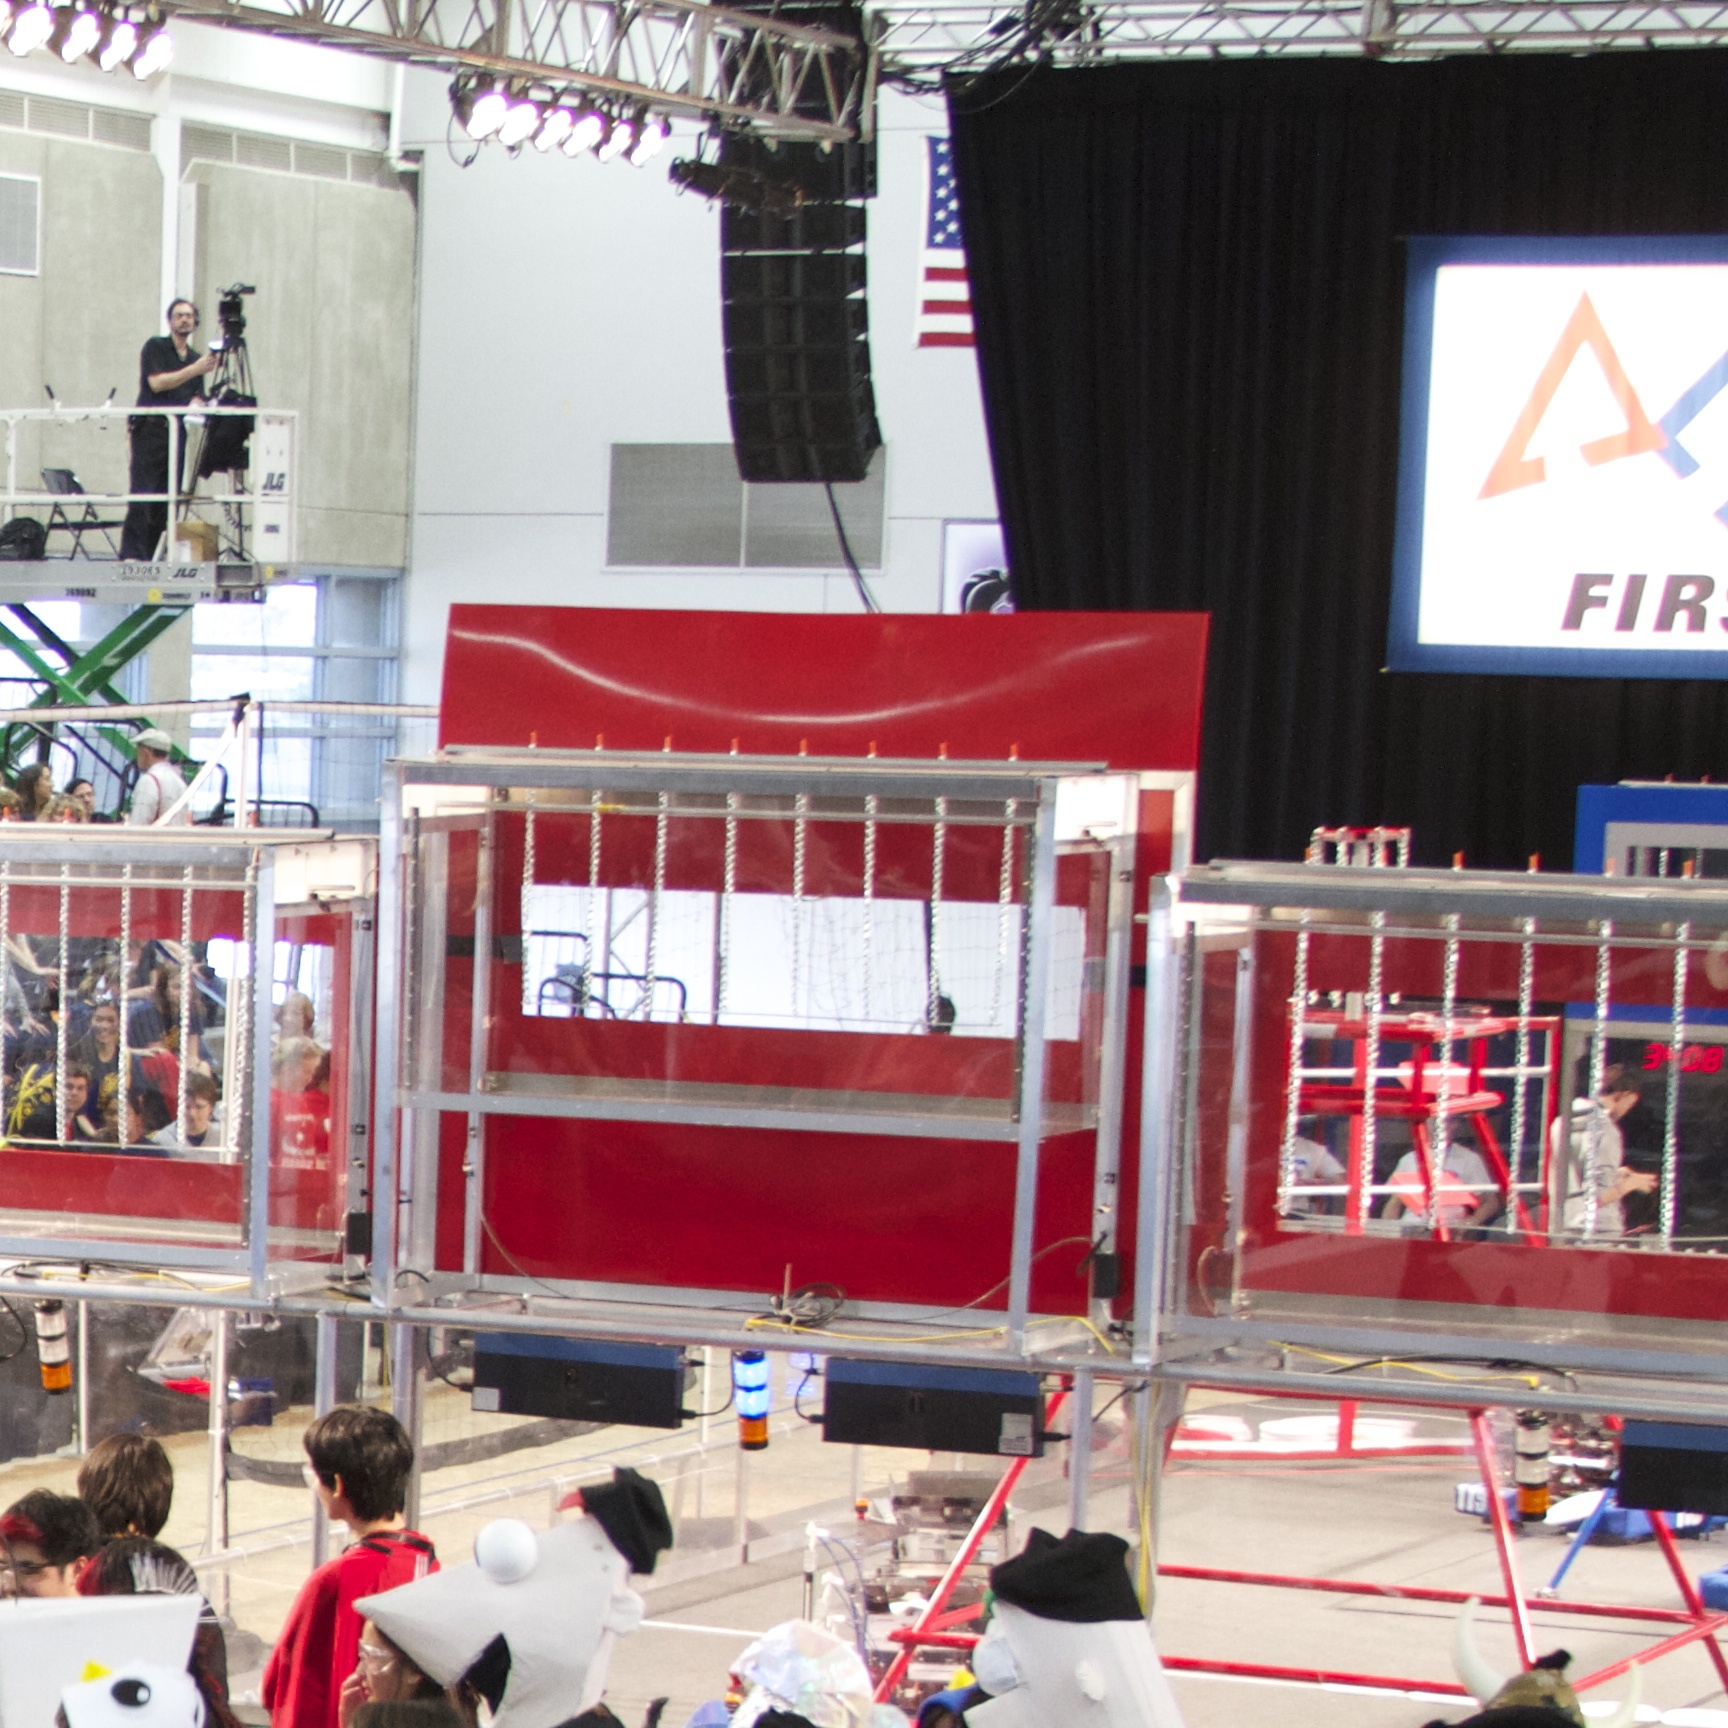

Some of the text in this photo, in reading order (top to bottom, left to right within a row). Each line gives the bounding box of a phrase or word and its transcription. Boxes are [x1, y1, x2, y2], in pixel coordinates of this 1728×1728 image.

[262, 472, 286, 491] JLG
[173, 567, 199, 579] JLG
[1561, 573, 1728, 633] FIR
